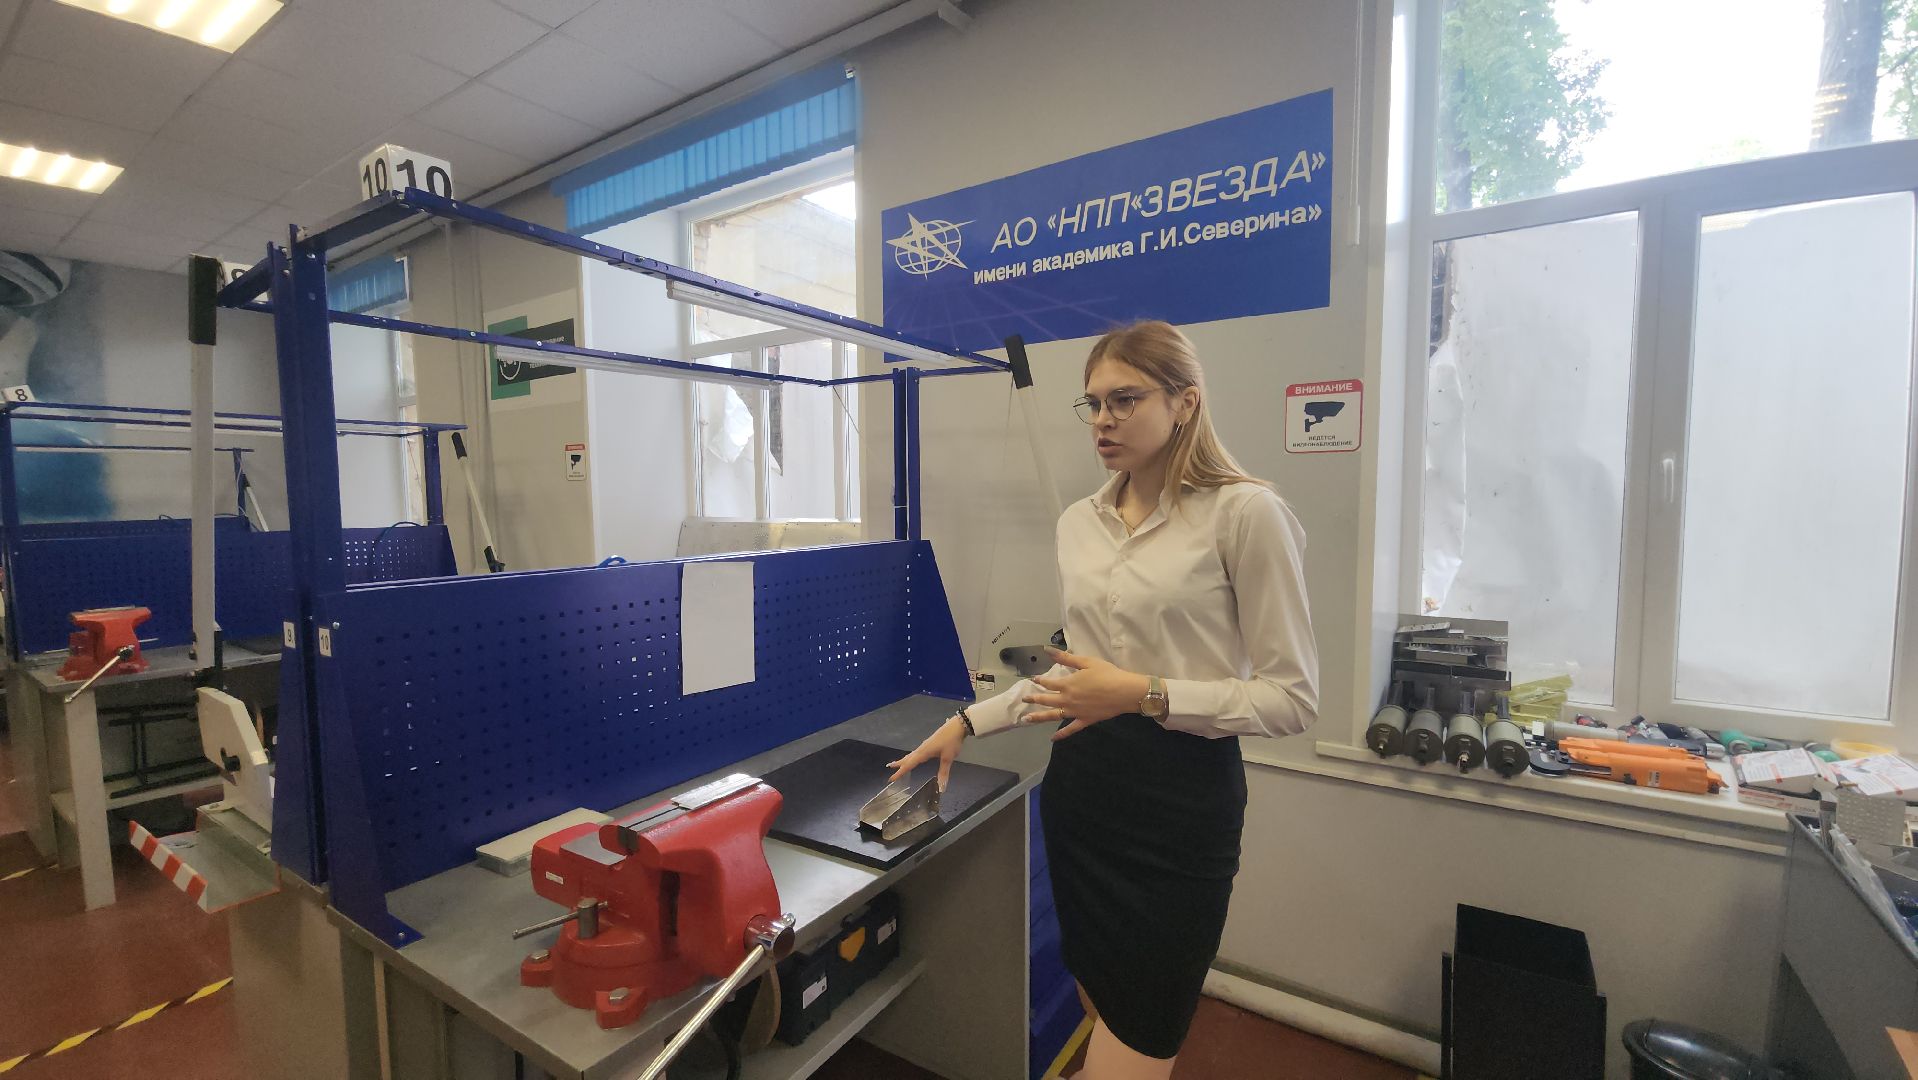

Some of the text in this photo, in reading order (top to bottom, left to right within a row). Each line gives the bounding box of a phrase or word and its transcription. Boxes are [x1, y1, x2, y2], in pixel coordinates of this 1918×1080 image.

[363, 158, 387, 198] 10
[397, 159, 452, 199] 10
[990, 216, 1037, 253] АО
[973, 261, 1026, 285] имени
[1032, 240, 1134, 273] академика
[15, 388, 28, 401] 8
[1295, 382, 1353, 395] ВНИМАНИЕ
